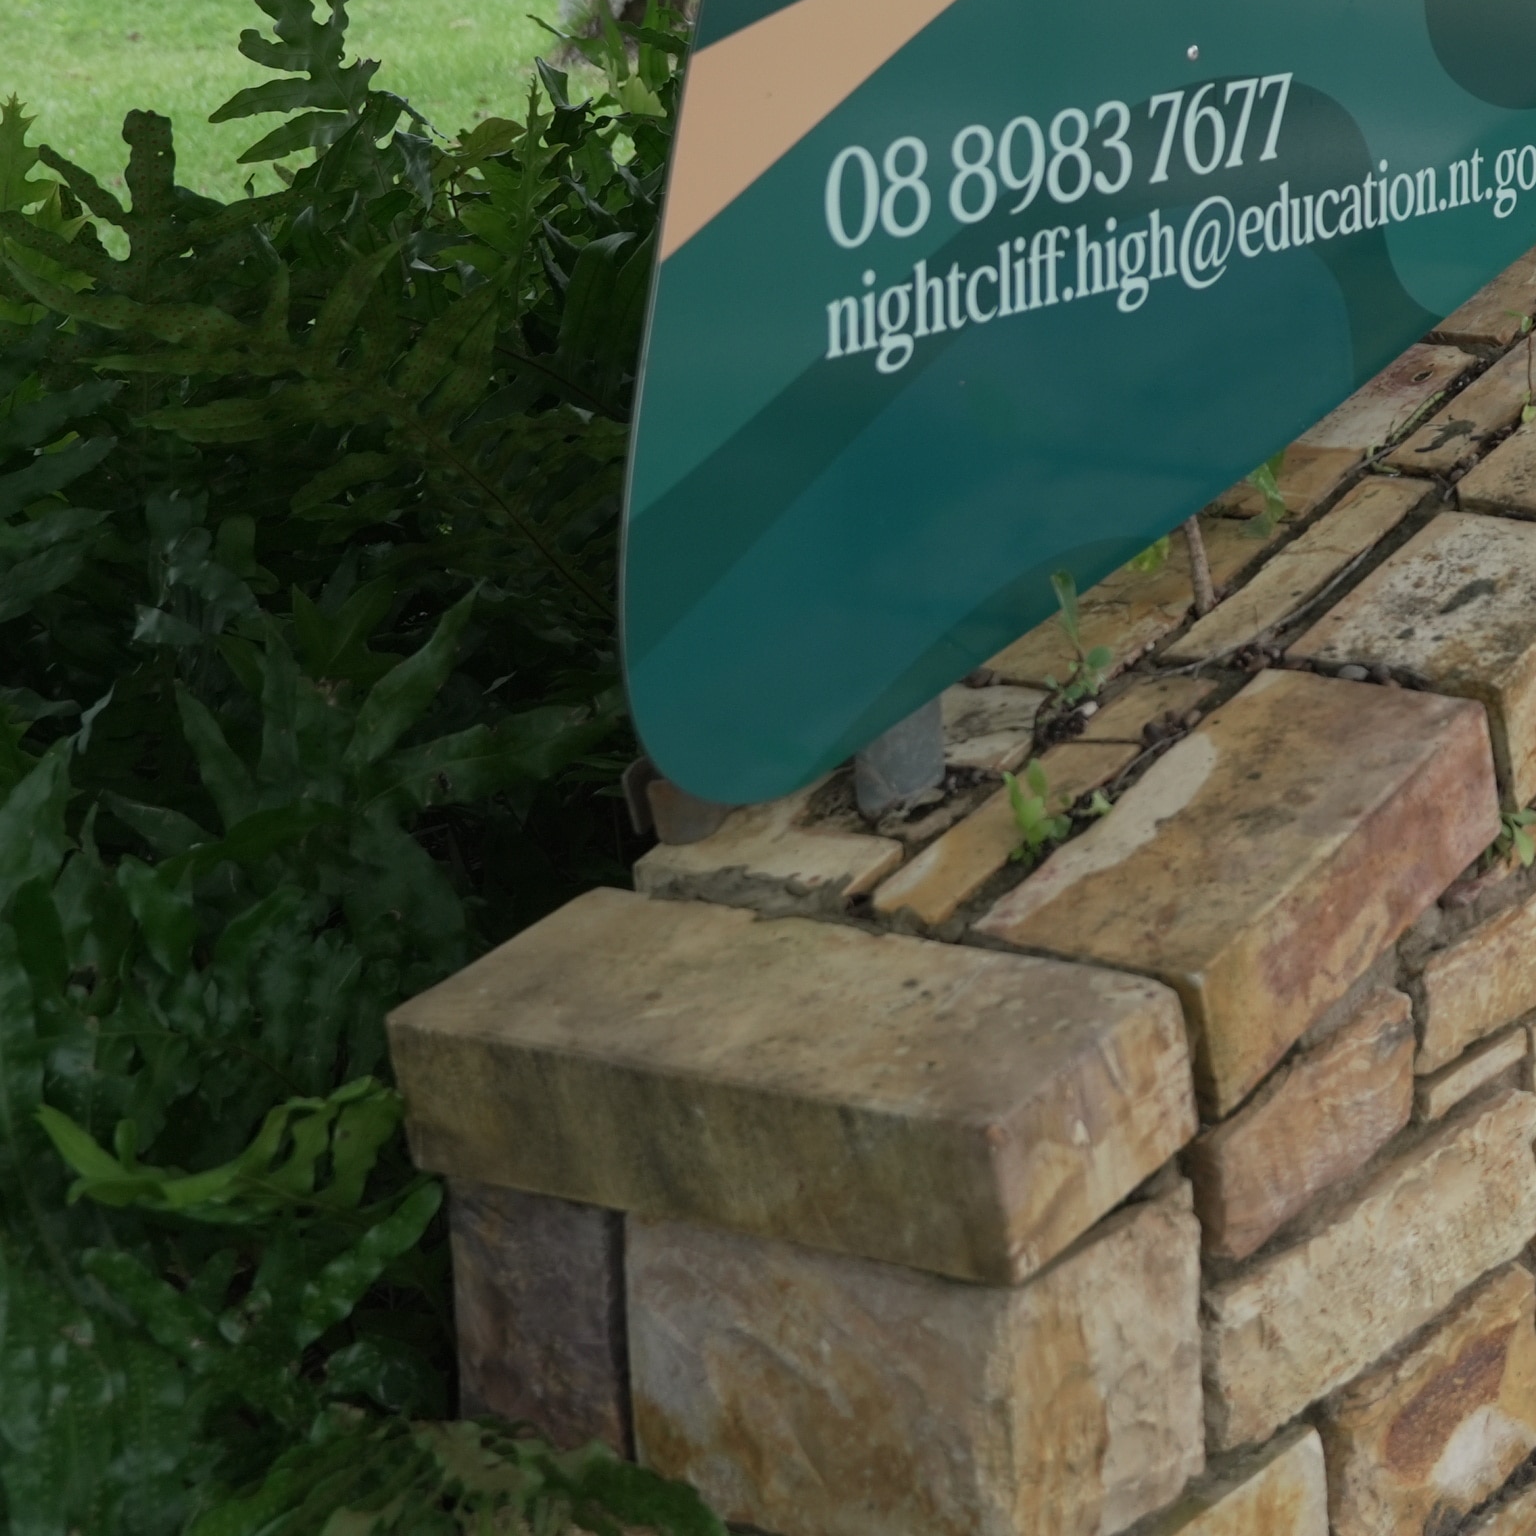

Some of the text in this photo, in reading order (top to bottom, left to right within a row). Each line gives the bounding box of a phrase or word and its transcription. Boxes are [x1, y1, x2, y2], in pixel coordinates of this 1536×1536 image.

[825, 72, 1293, 249] 08 8983 7677
